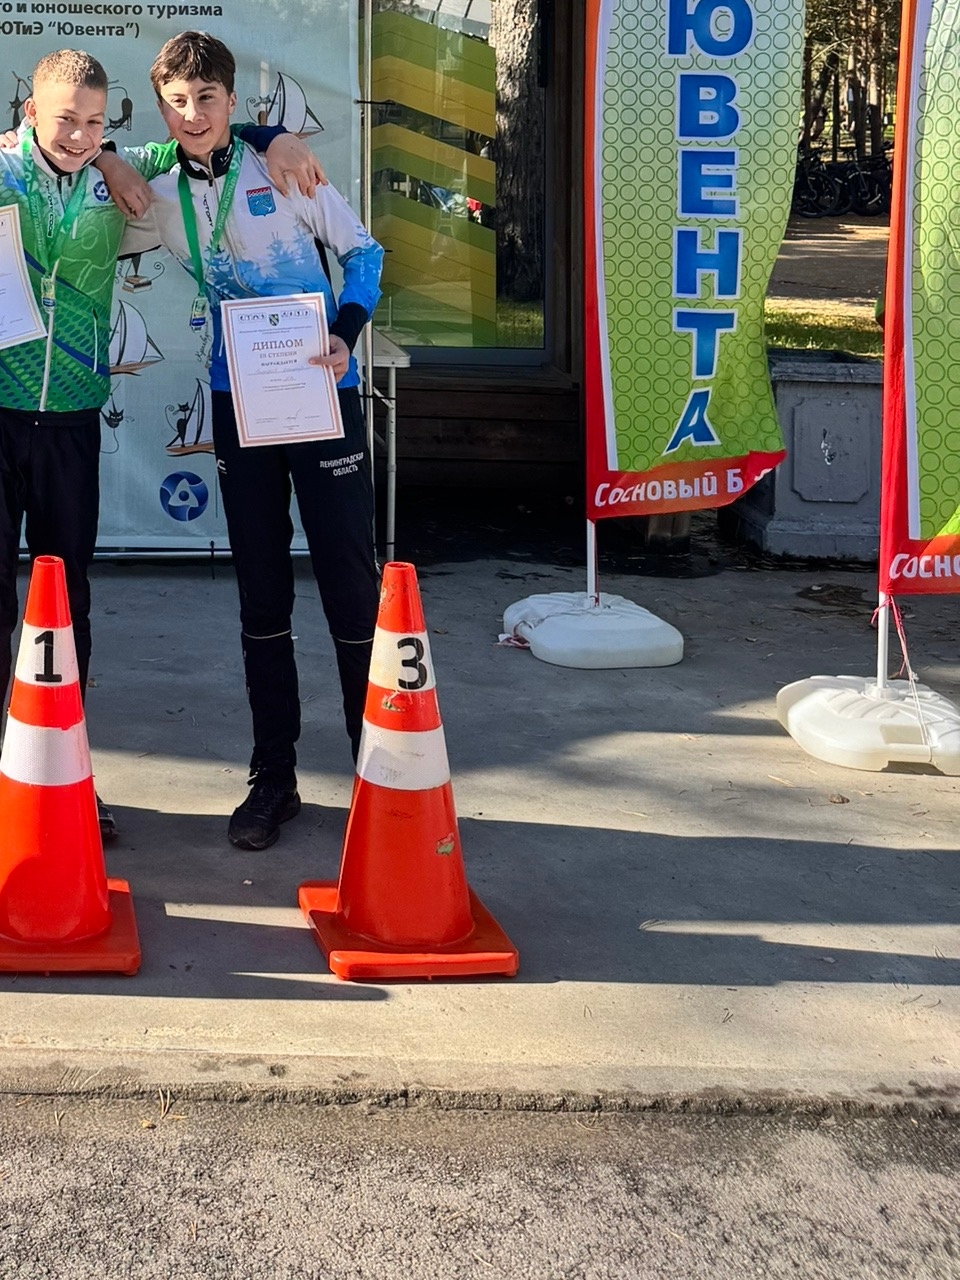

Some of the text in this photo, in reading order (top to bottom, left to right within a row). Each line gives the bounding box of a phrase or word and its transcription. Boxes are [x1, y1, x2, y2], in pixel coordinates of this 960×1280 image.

[16, 4, 27, 13] и
[31, 3, 143, 16] юношеского
[147, 4, 223, 18] туризма
[251, 338, 304, 352] ДИПЛОМ
[594, 471, 718, 508] Сосновый
[33, 629, 64, 683] 1
[397, 636, 429, 691] 3
